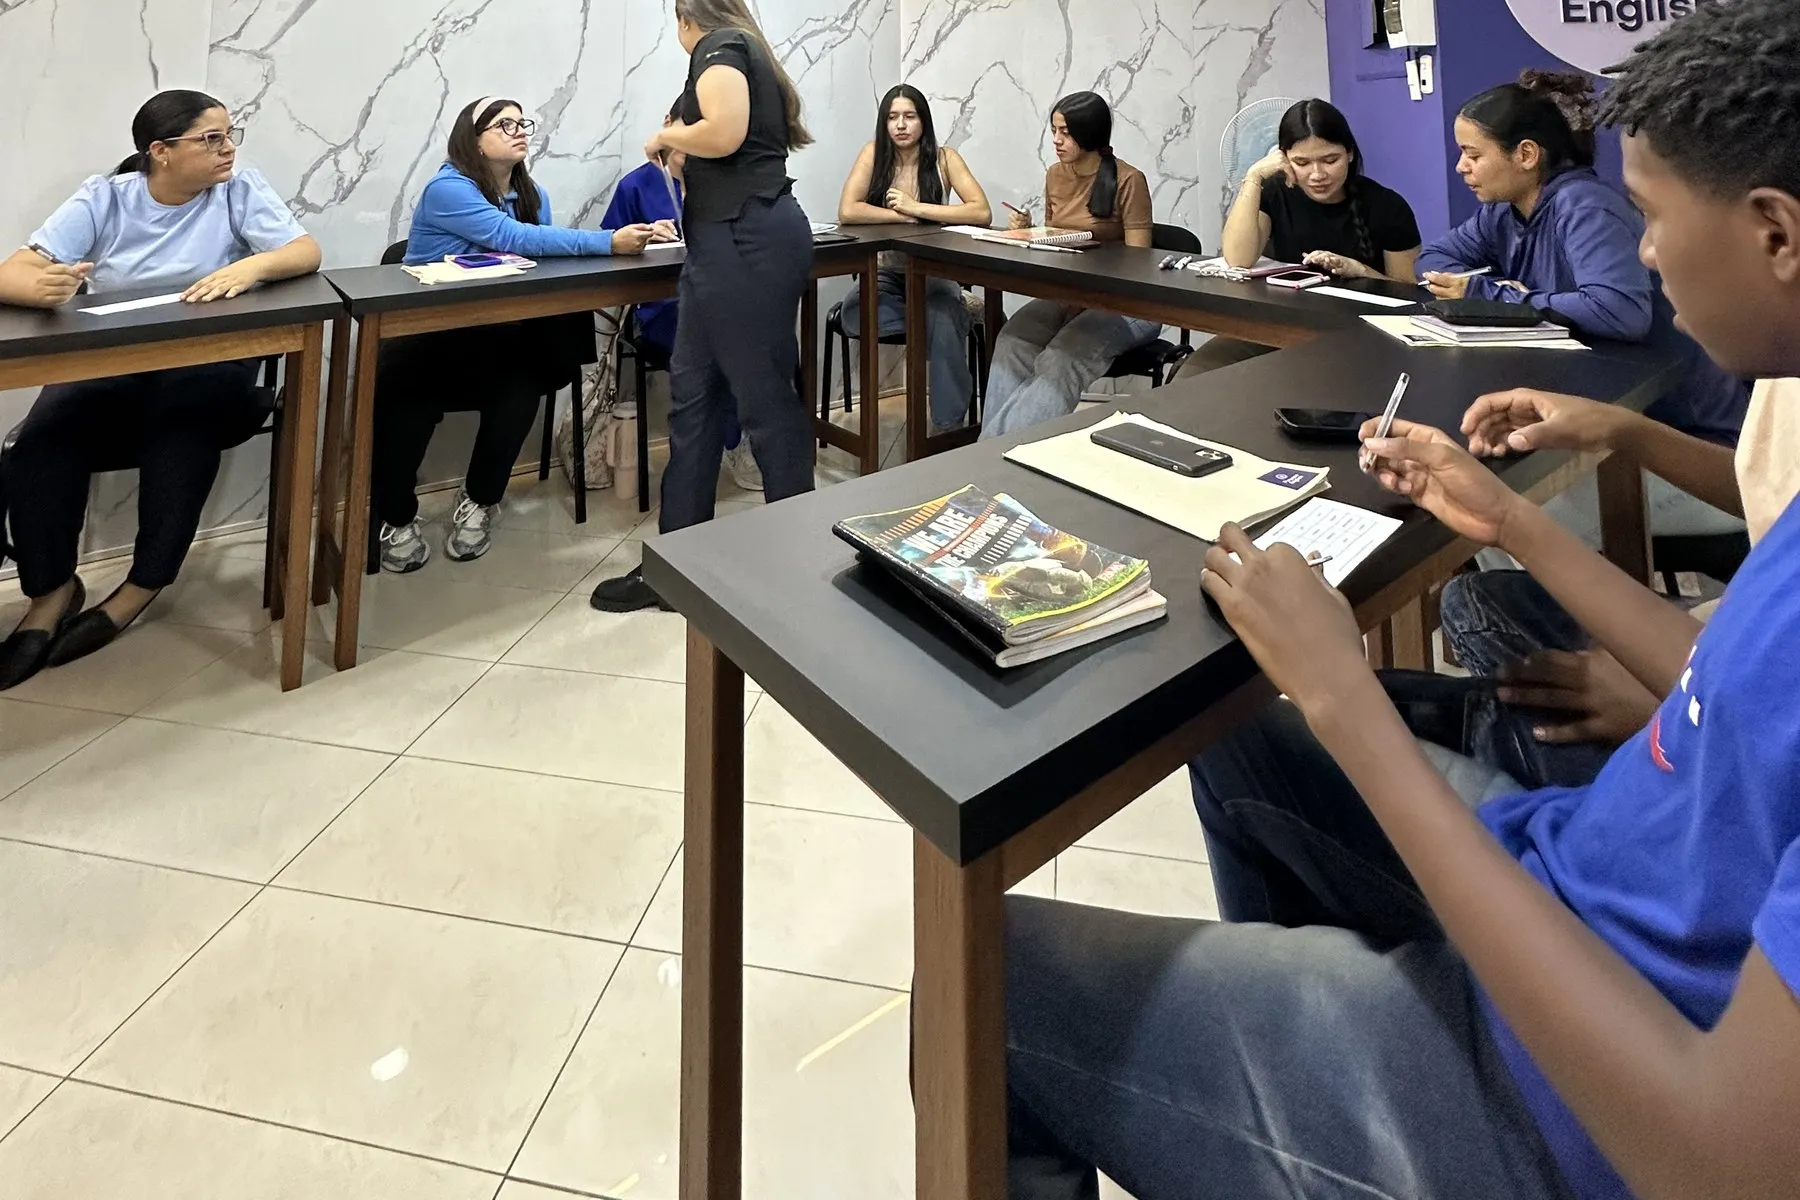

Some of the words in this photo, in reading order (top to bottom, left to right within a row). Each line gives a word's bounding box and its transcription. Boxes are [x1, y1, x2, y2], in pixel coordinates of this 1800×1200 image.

[901, 530, 949, 554] WE
[928, 507, 977, 539] ARE
[934, 553, 966, 568] THE
[951, 513, 1009, 559] CHAMPIONS
